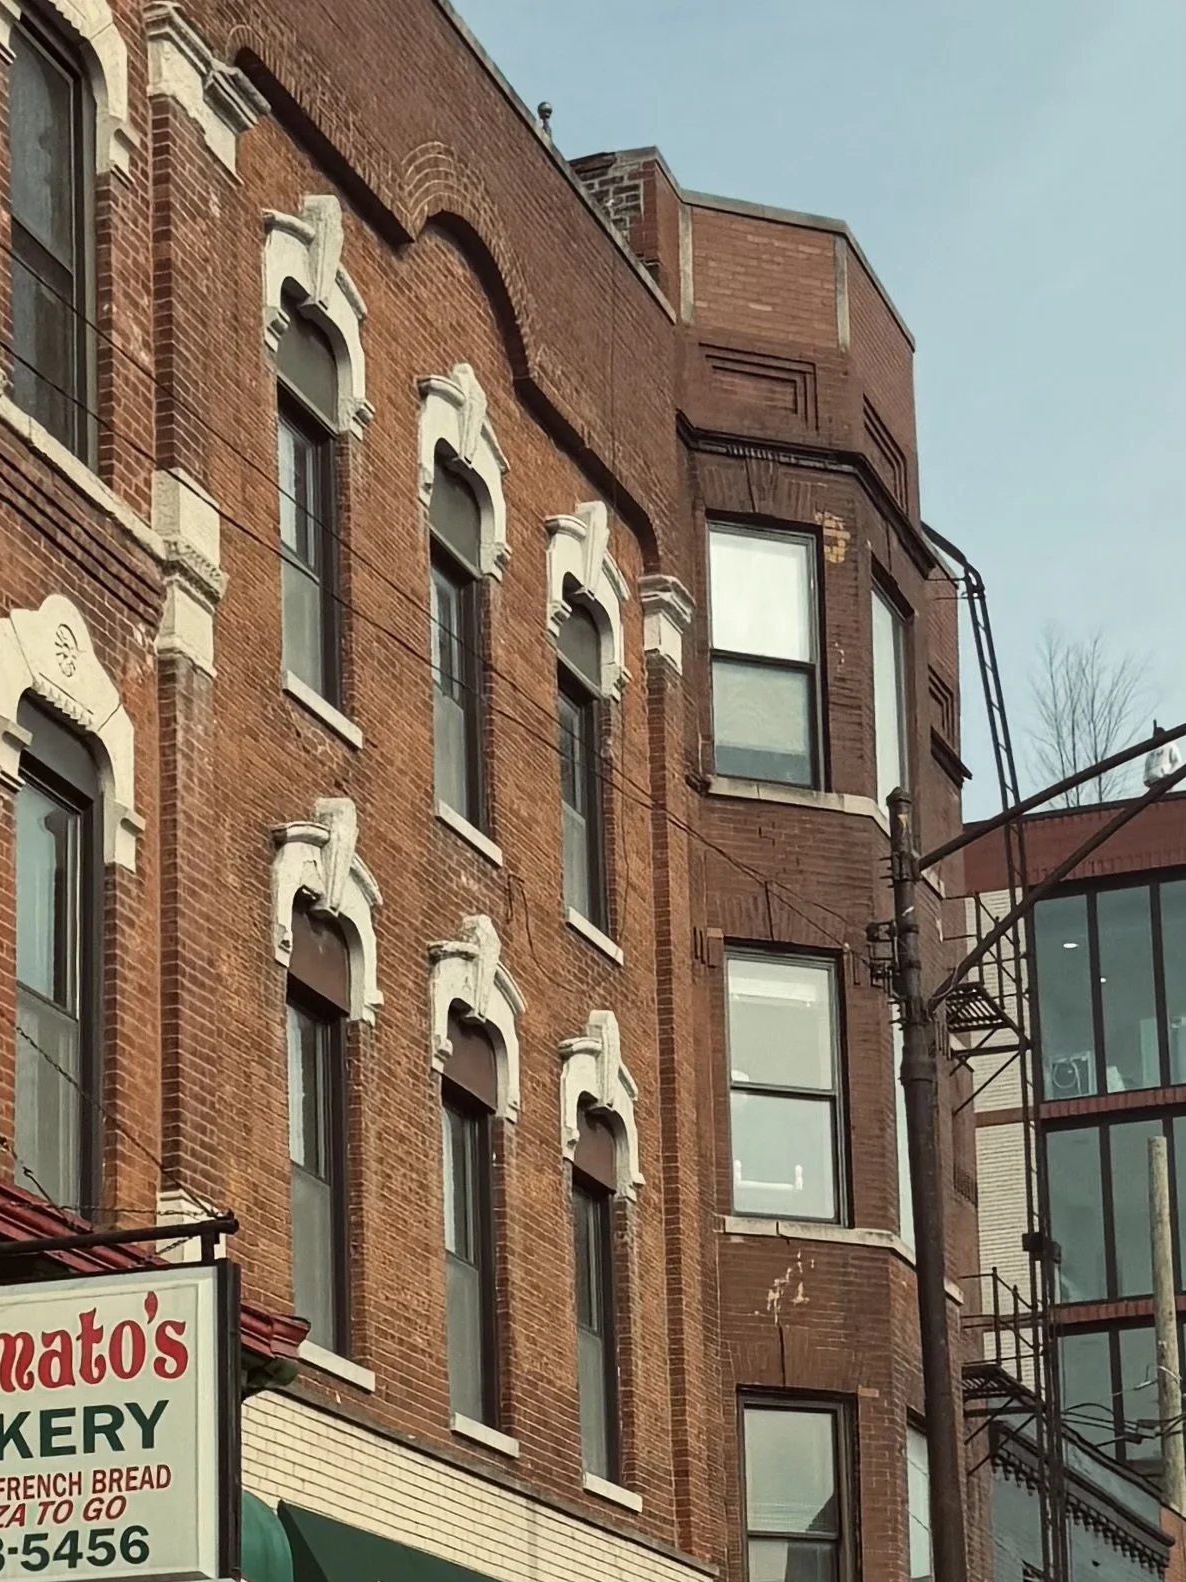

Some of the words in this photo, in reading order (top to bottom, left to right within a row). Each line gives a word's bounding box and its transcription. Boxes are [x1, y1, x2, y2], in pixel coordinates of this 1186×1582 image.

[92, 1463, 172, 1495] BREAD
[36, 1499, 74, 1526] TO
[82, 1495, 128, 1522] GO
